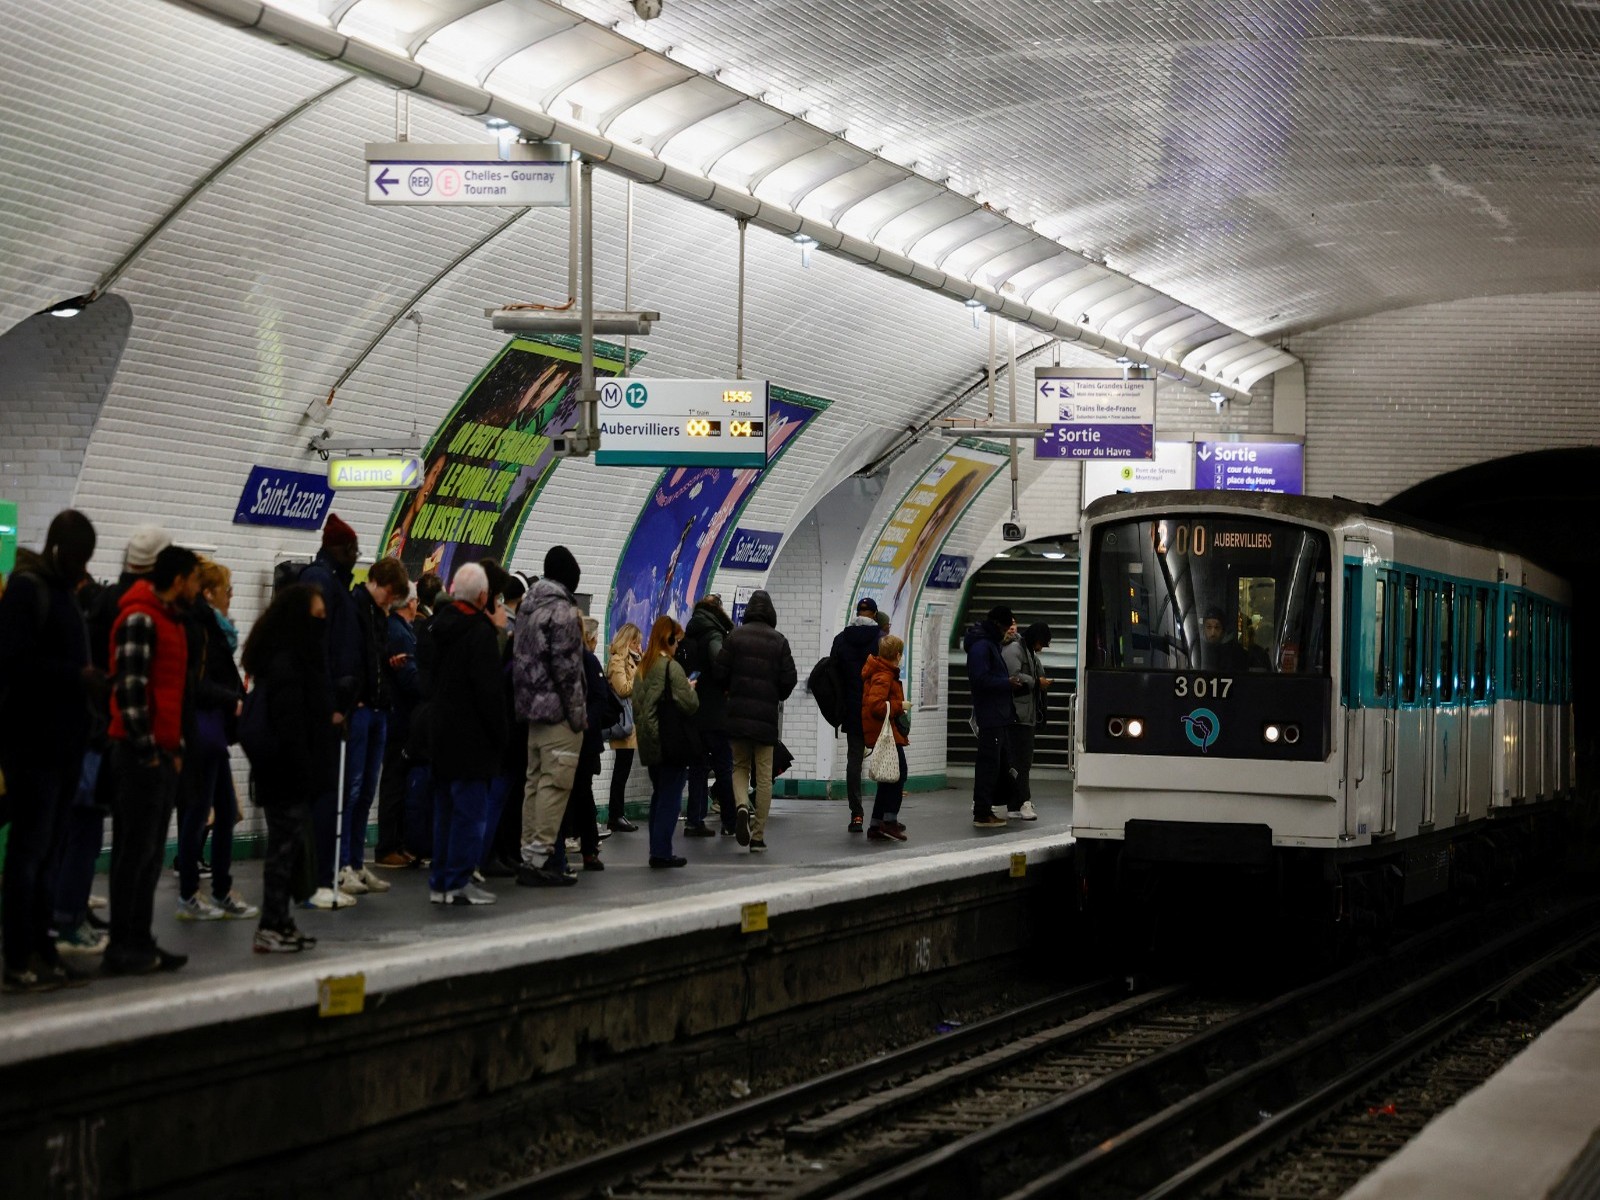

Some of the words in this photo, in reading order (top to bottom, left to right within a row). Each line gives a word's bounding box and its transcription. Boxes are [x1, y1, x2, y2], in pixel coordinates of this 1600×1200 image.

[412, 176, 430, 188] RER
[444, 176, 452, 190] E
[464, 170, 502, 181] Chelles
[511, 170, 555, 183] Gournay
[464, 184, 506, 194] Tournan
[1124, 383, 1144, 392] Lignes
[605, 388, 618, 402] M
[628, 388, 645, 404] 12
[1096, 404, 1136, 412] Île-de-France
[600, 422, 680, 436] Aubervilliers
[687, 419, 710, 436] 00
[730, 420, 752, 437] 04
[448, 422, 480, 454] ON
[461, 424, 504, 458] PEUT
[1058, 428, 1100, 442] Sortie
[1060, 448, 1066, 456] 9
[1093, 447, 1104, 456] du
[1106, 448, 1131, 456] Havre
[1214, 447, 1257, 462] Sortie
[337, 466, 392, 482] Alarme
[1124, 469, 1130, 478] 9
[1253, 466, 1272, 474] Rome
[436, 462, 464, 496] LE
[450, 464, 493, 500] POING
[1226, 476, 1245, 485] place
[1245, 476, 1255, 484] du
[1255, 477, 1276, 485] Havre
[250, 478, 326, 520] Saint-Lazare
[411, 502, 436, 539] OU
[425, 504, 464, 542] JUSTE
[1214, 532, 1272, 549] AUBERVILLIERS
